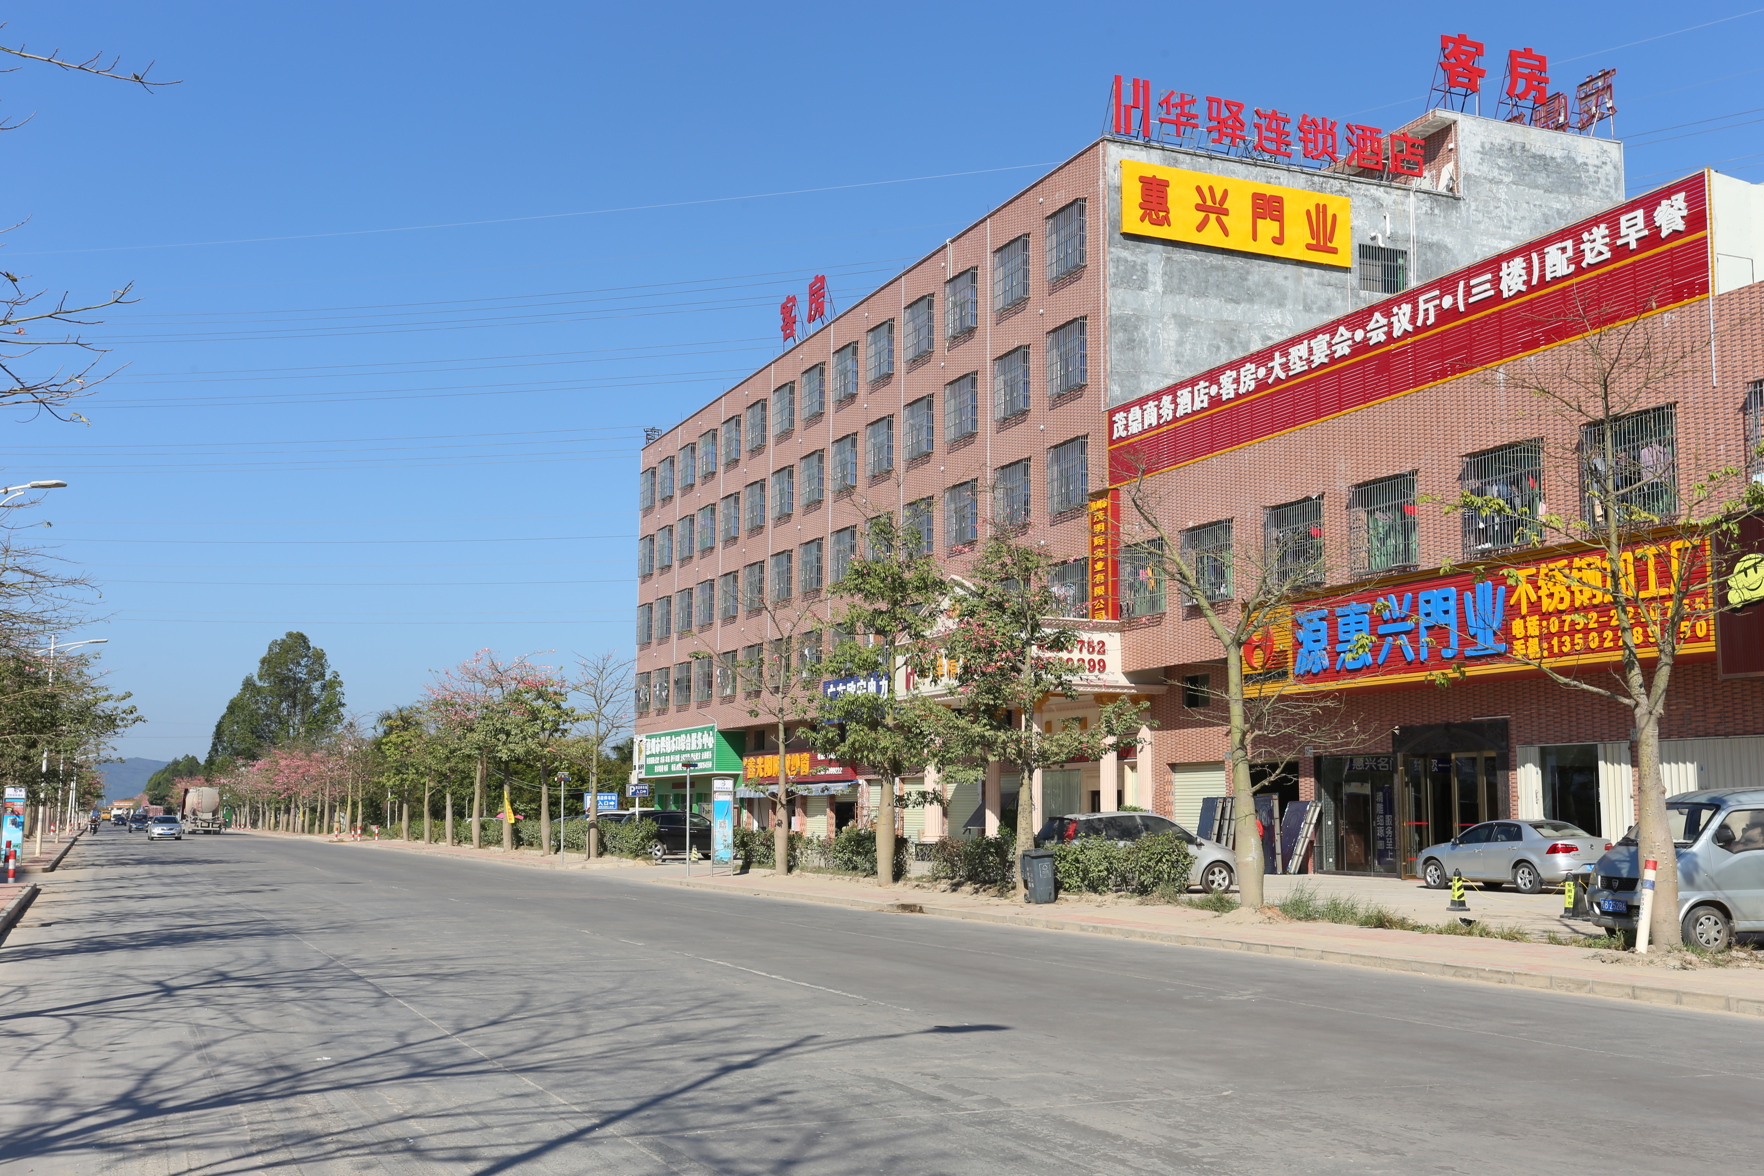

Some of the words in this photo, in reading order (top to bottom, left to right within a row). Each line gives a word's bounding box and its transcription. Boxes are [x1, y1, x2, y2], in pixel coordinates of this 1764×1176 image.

[1440, 33, 1550, 104] 客房
[1158, 90, 1425, 178] 华驿连锁酒店
[1137, 174, 1339, 254] 惠兴門业
[780, 274, 826, 342] 客房
[1509, 538, 1707, 616] 不锈钢加工厂
[1294, 580, 1507, 676] 源惠兴門业
